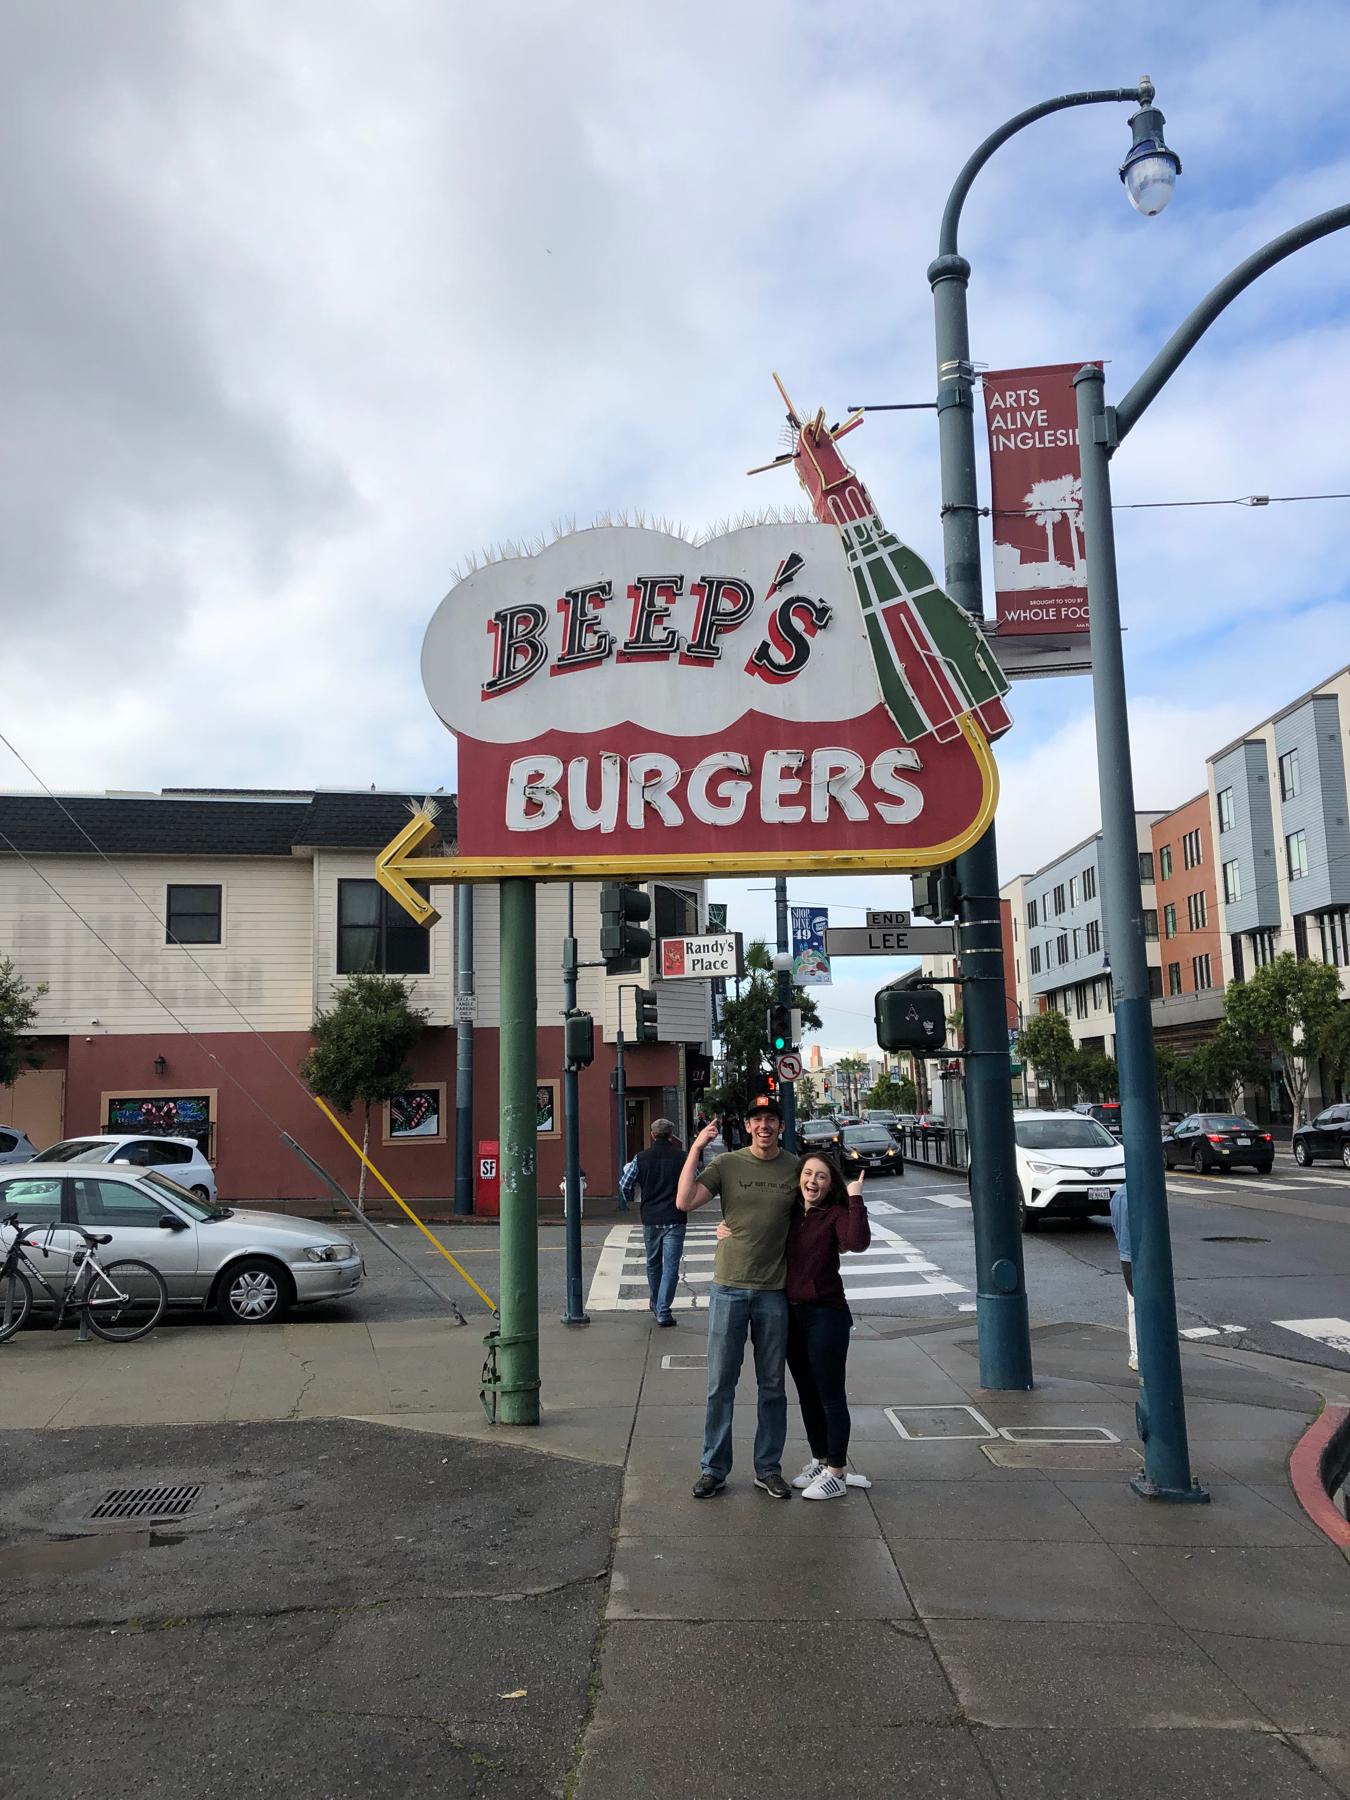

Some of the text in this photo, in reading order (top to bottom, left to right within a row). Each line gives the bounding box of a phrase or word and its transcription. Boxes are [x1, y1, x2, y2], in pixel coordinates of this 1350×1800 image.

[989, 389, 1040, 409] ARTS
[991, 409, 1048, 430] ALIVE
[1005, 608, 1056, 621] WHOLE
[480, 551, 834, 702] BEEP'S
[505, 746, 925, 833] BURGERS
[872, 913, 905, 924] END
[793, 929, 811, 940] 49
[868, 933, 909, 949] LEE
[686, 939, 734, 956] Randy's
[692, 958, 728, 971] Place
[482, 1161, 495, 1175] SF
